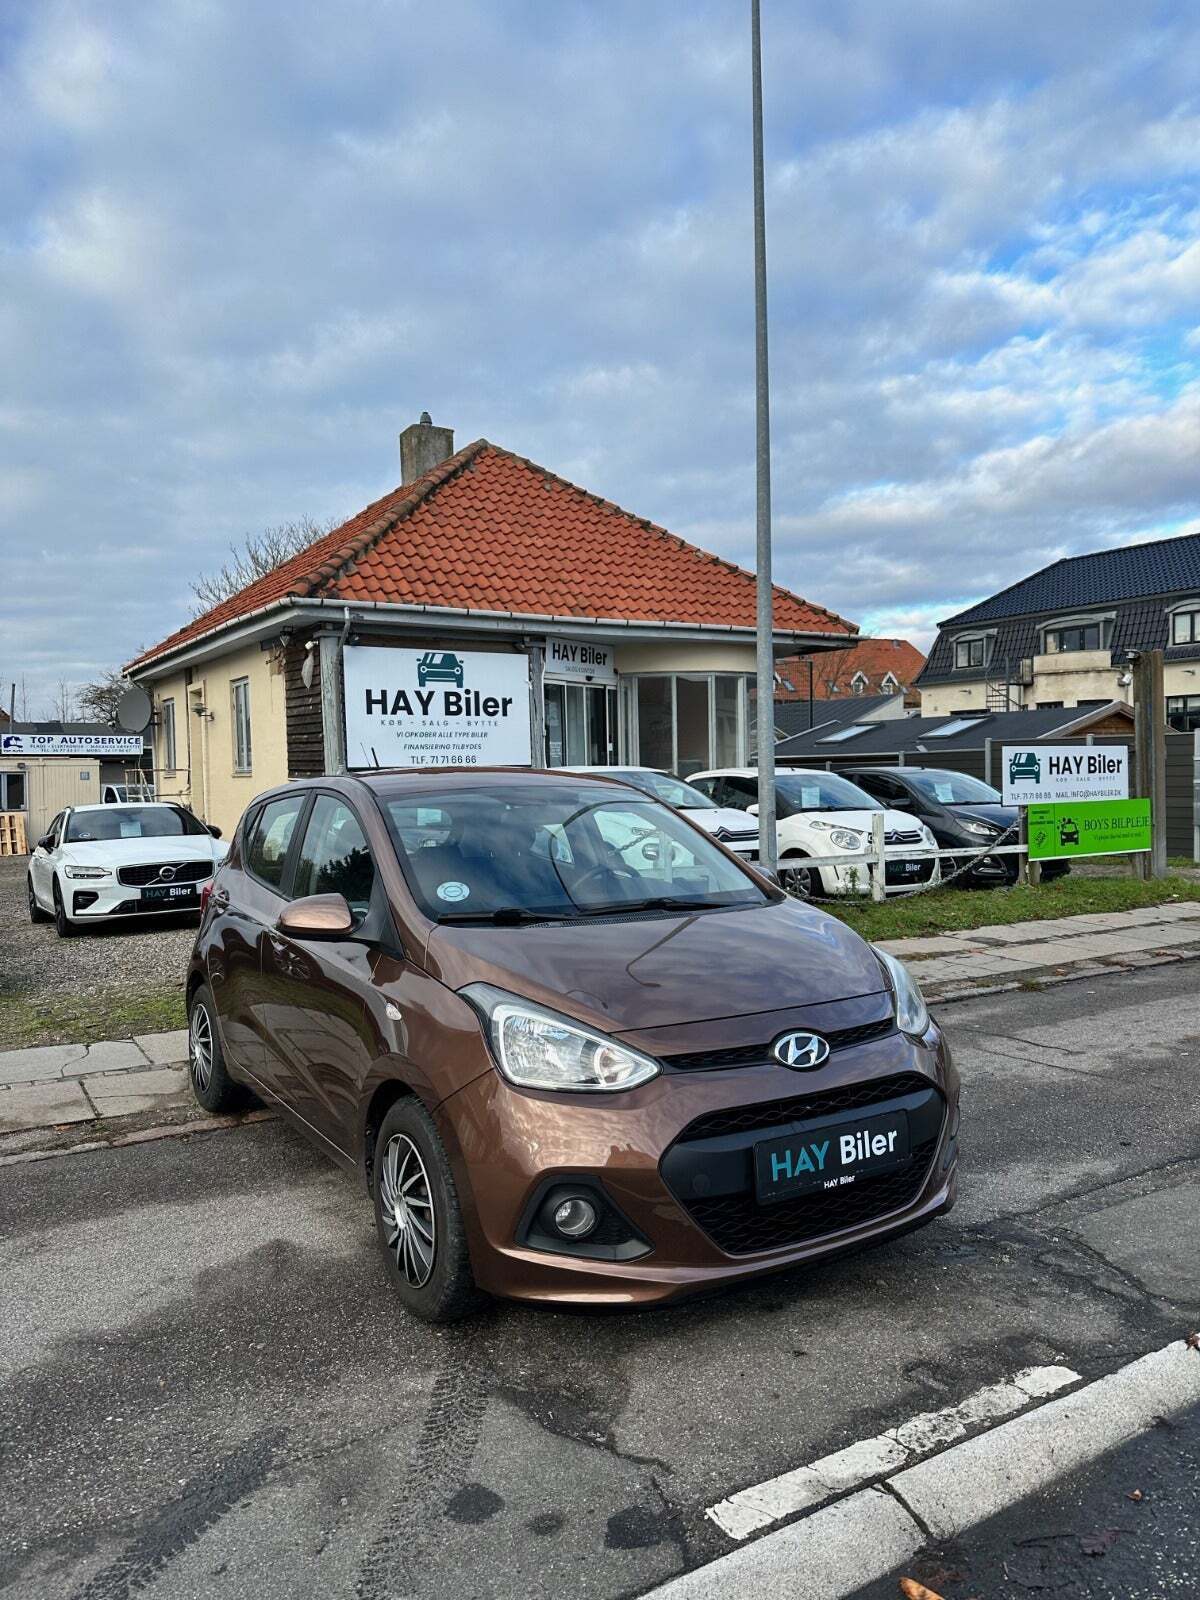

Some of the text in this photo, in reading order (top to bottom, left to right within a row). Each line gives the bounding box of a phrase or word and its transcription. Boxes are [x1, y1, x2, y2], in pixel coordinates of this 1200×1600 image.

[552, 643, 607, 665] HAY Biler
[365, 688, 512, 717] HAY Biler
[30, 736, 140, 745] TOP AUTOSERVICE
[410, 755, 477, 764] TLF. 71 71 66 66
[1049, 753, 1122, 775] HAY Biler
[1084, 815, 1149, 831] BOYS BILPLEJE
[905, 863, 921, 872] Biler
[146, 887, 191, 898] HAY Biler
[771, 1130, 897, 1182] HAY Biler
[823, 1174, 855, 1189] HAY Biler
